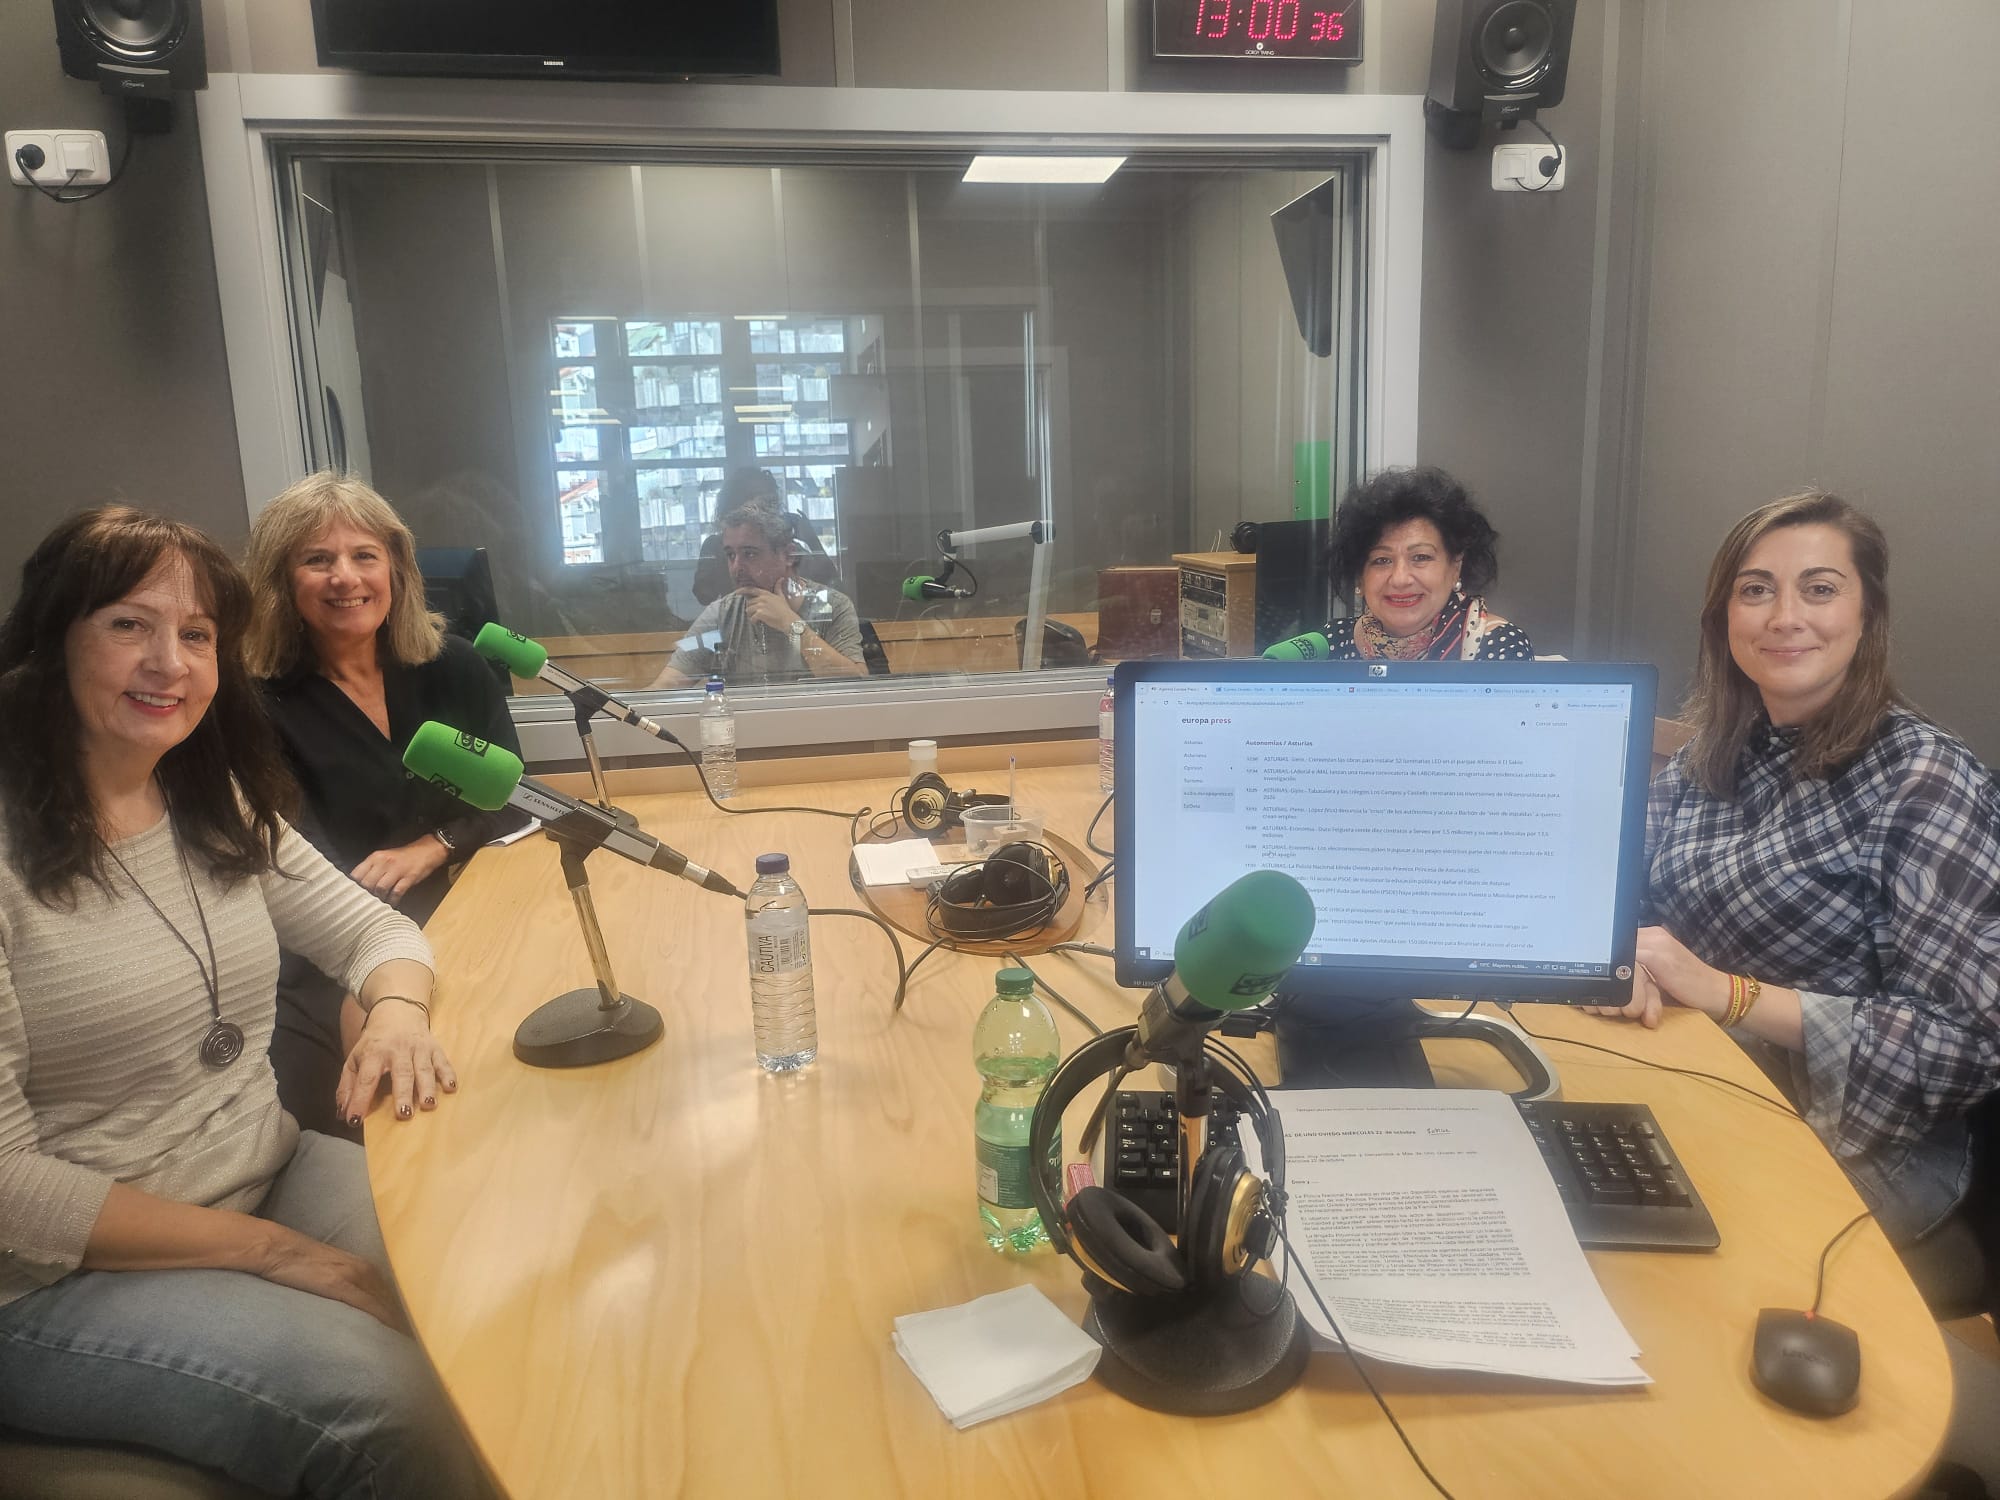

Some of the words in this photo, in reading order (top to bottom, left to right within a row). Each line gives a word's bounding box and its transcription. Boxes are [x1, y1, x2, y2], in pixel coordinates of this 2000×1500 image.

[1310, 12, 1344, 40] 36
[1181, 717, 1209, 725] europa
[1210, 717, 1232, 725] press
[758, 935, 775, 973] CAUTIVA
